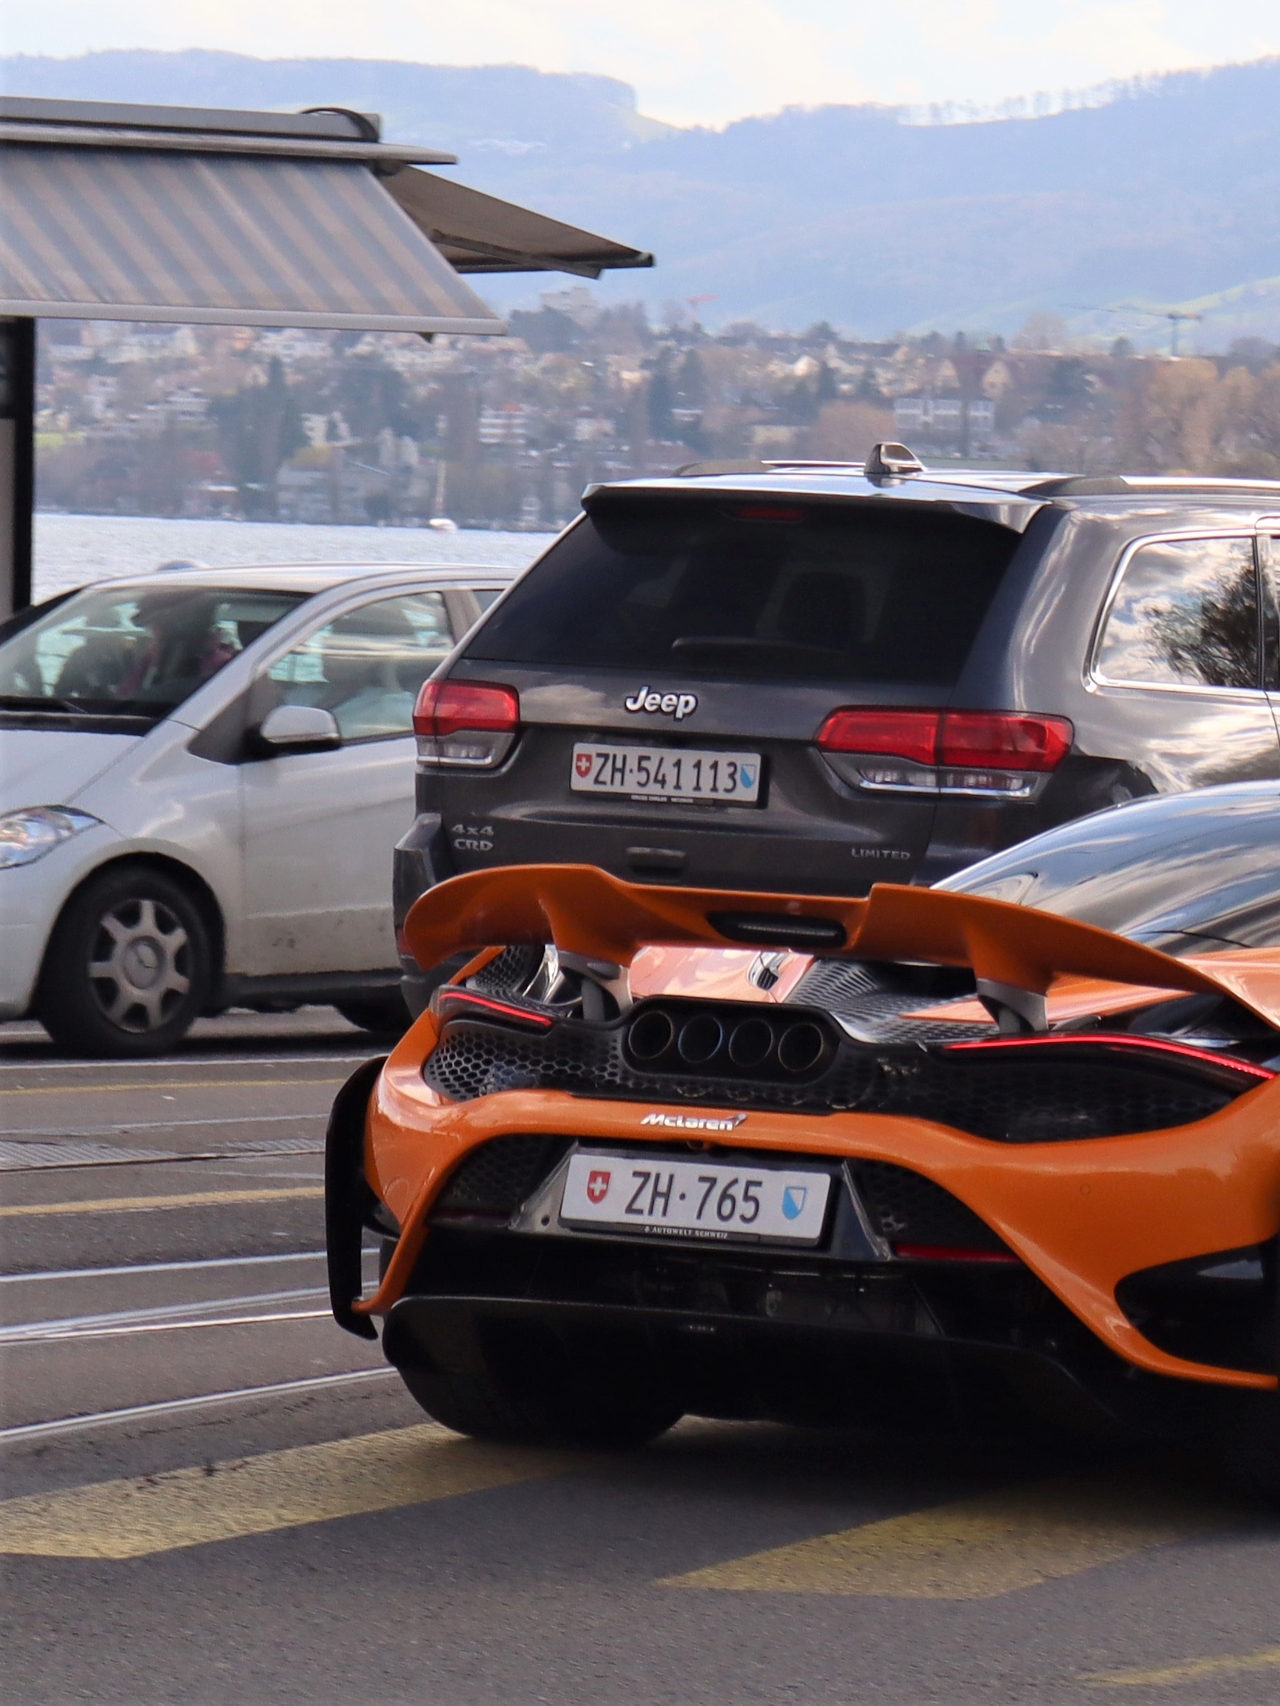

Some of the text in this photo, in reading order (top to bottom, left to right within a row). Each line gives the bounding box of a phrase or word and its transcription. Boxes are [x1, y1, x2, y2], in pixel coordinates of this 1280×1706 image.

[626, 686, 697, 718] Jeep
[452, 824, 494, 836] 4x4
[454, 838, 493, 851] CRD
[851, 848, 911, 860] LIMITED
[640, 1113, 736, 1131] McLaren
[651, 1226, 728, 1239] AUTOWELT SCHWEIZ
